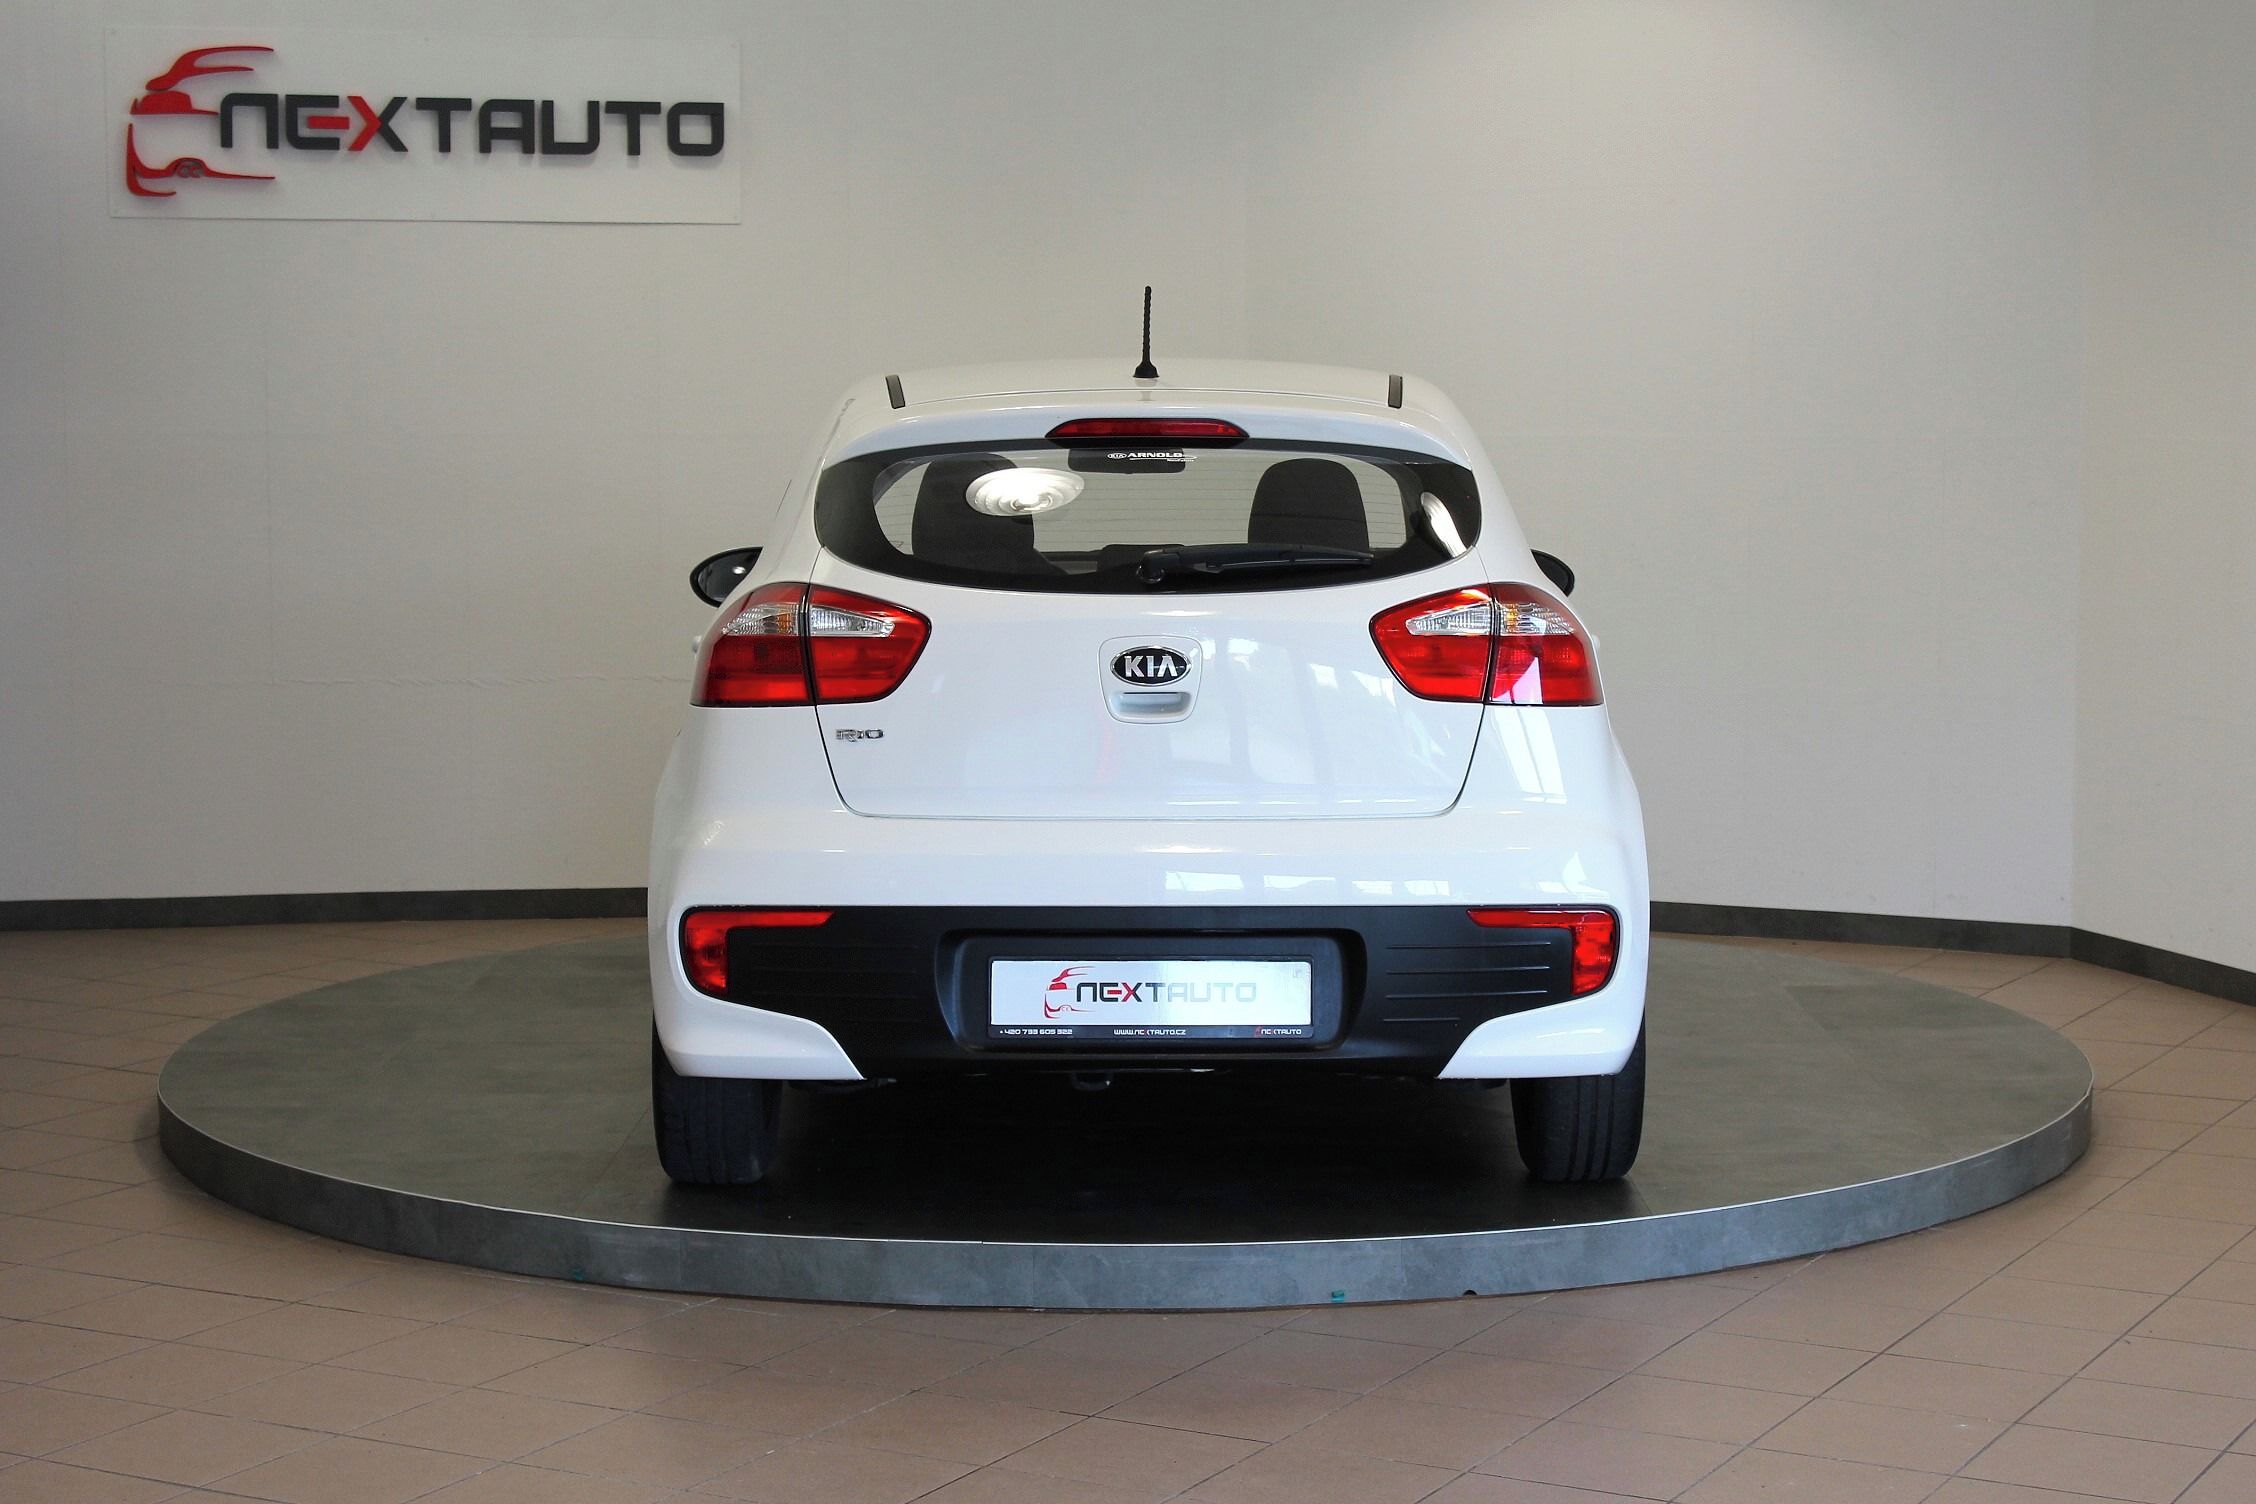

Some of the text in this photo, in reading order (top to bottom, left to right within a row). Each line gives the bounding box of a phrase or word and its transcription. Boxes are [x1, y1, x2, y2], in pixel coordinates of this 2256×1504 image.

[219, 92, 725, 157] NEXTAUTO
[1124, 655, 1178, 678] KIA
[836, 729, 884, 742] RIO
[1076, 982, 1257, 1003] NEXTAUTO
